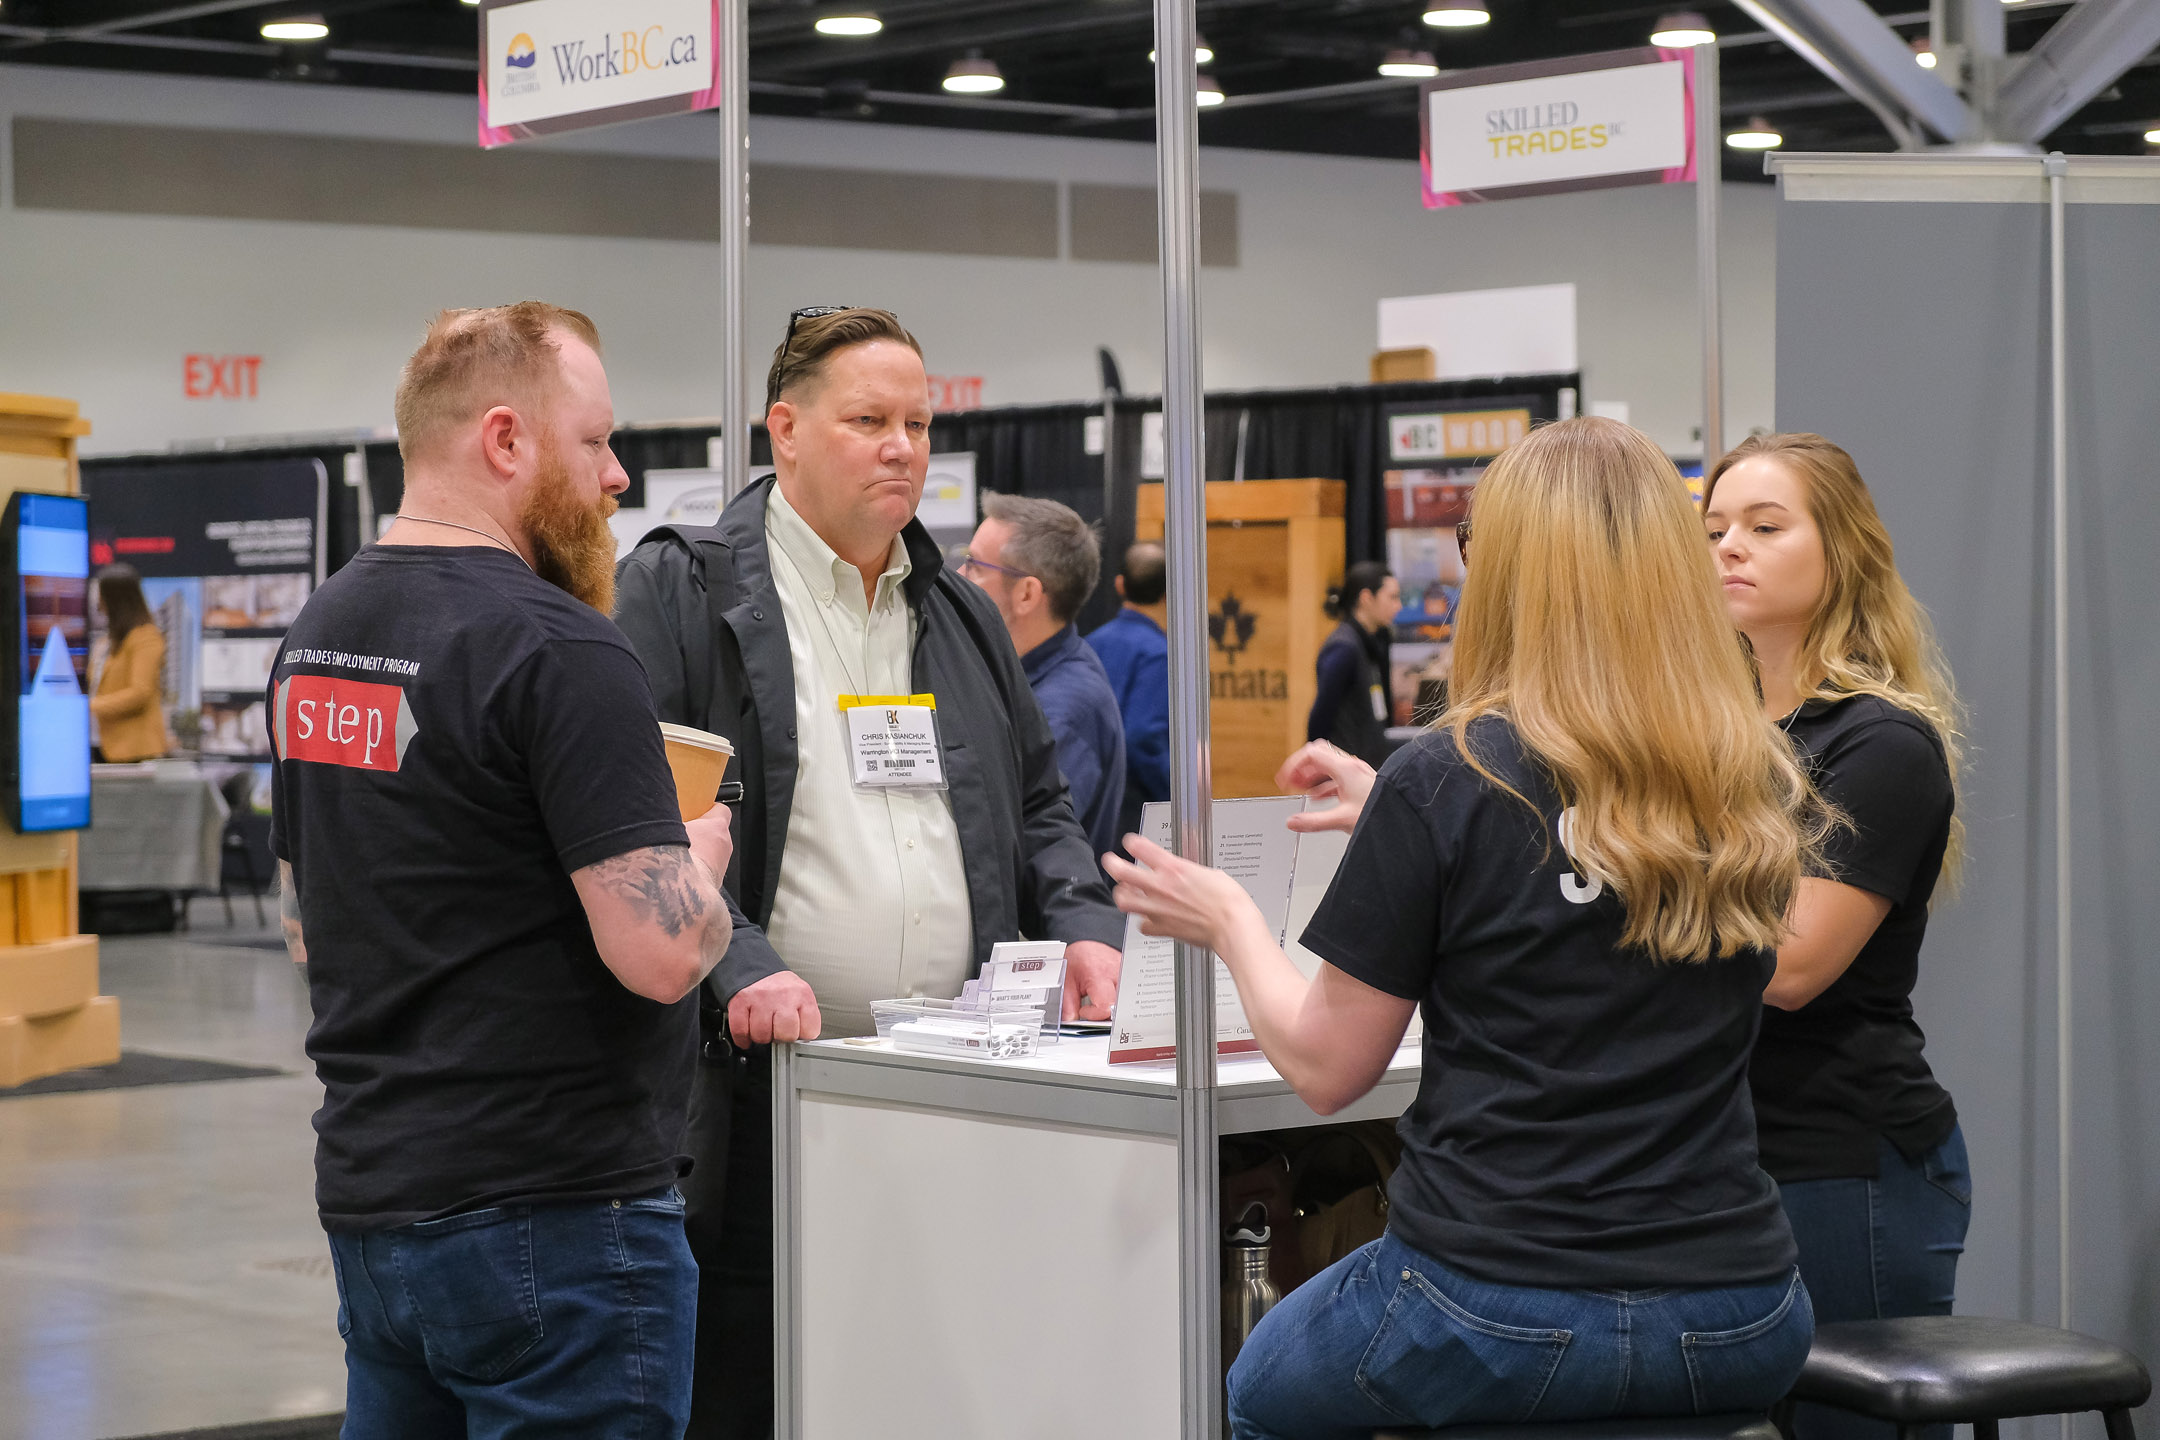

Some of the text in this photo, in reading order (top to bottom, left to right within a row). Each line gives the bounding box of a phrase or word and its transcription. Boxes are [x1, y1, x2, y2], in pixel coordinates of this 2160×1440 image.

[551, 25, 698, 87] WorkBC.ca
[1486, 101, 1579, 134] SKILLED
[1487, 124, 1609, 159] TRADES
[184, 355, 263, 400] EXIT
[284, 649, 302, 665] SKILLED
[302, 649, 332, 665] TRADES
[332, 651, 383, 671] EMPLOYMENT
[297, 690, 382, 765] step
[861, 733, 884, 741] CHRIS
[900, 747, 932, 755] Management
[1020, 961, 1041, 971] step
